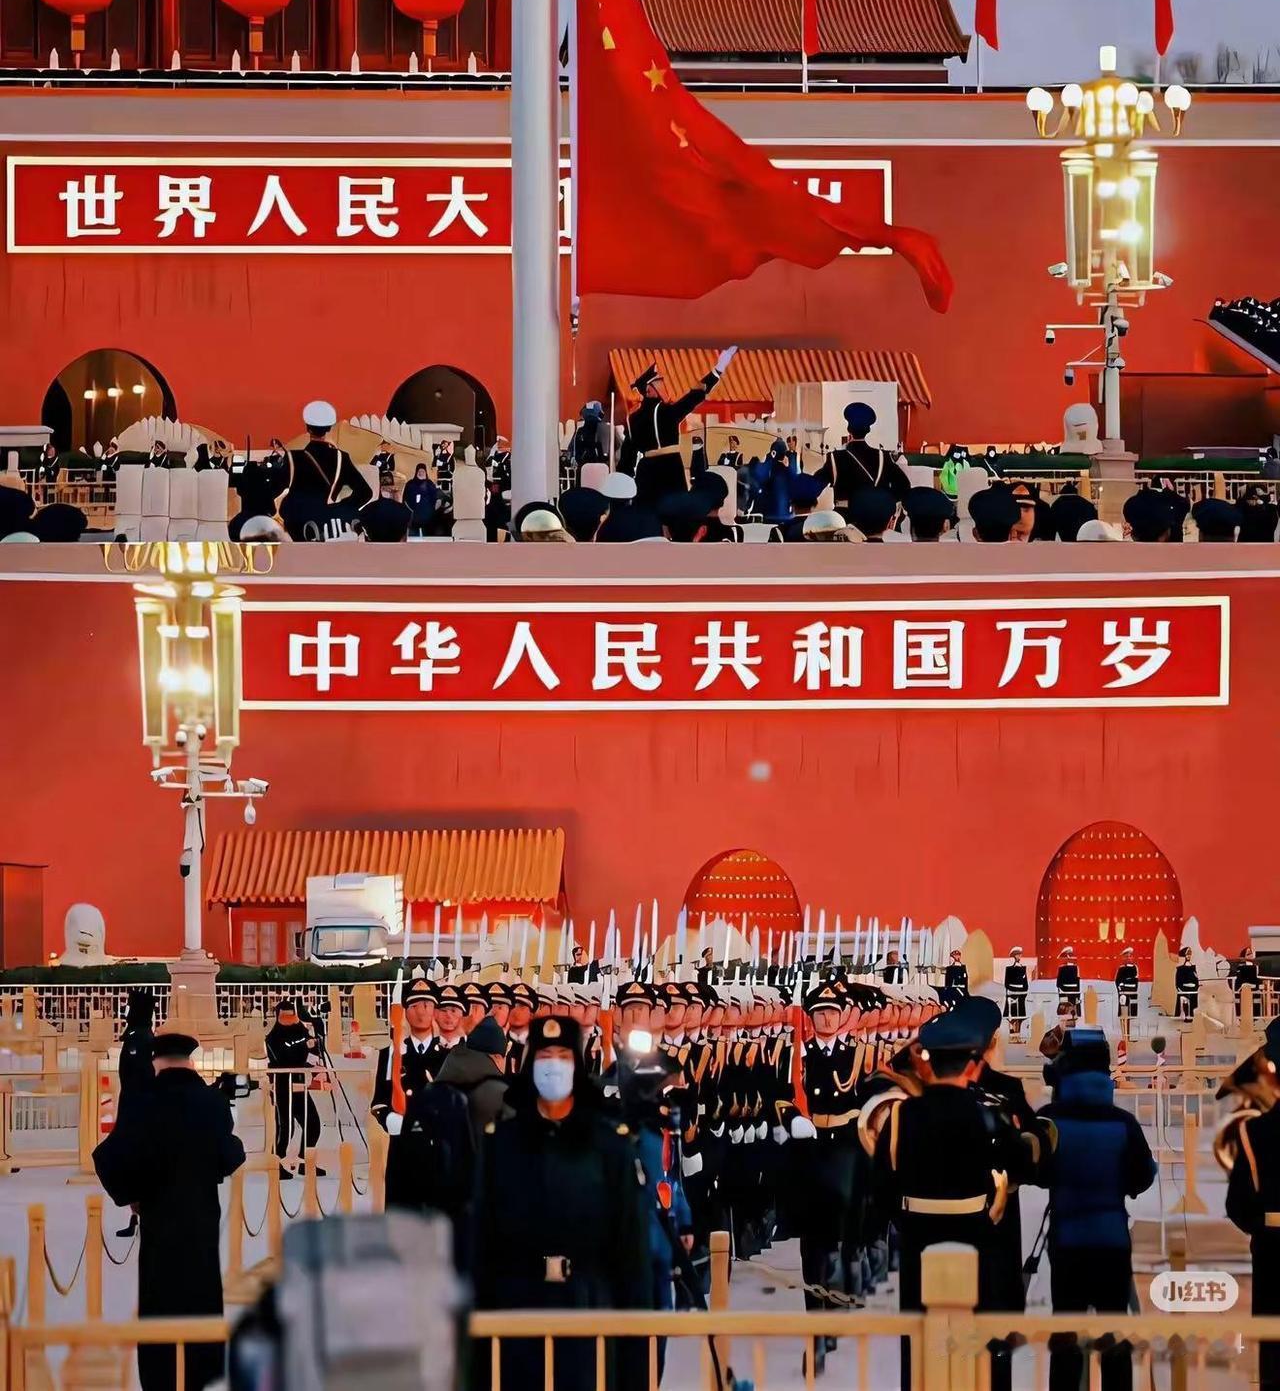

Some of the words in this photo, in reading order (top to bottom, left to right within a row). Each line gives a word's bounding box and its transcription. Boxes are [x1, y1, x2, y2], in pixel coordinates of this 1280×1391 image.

[288, 617, 1173, 693] 中华人民共和国万岁
